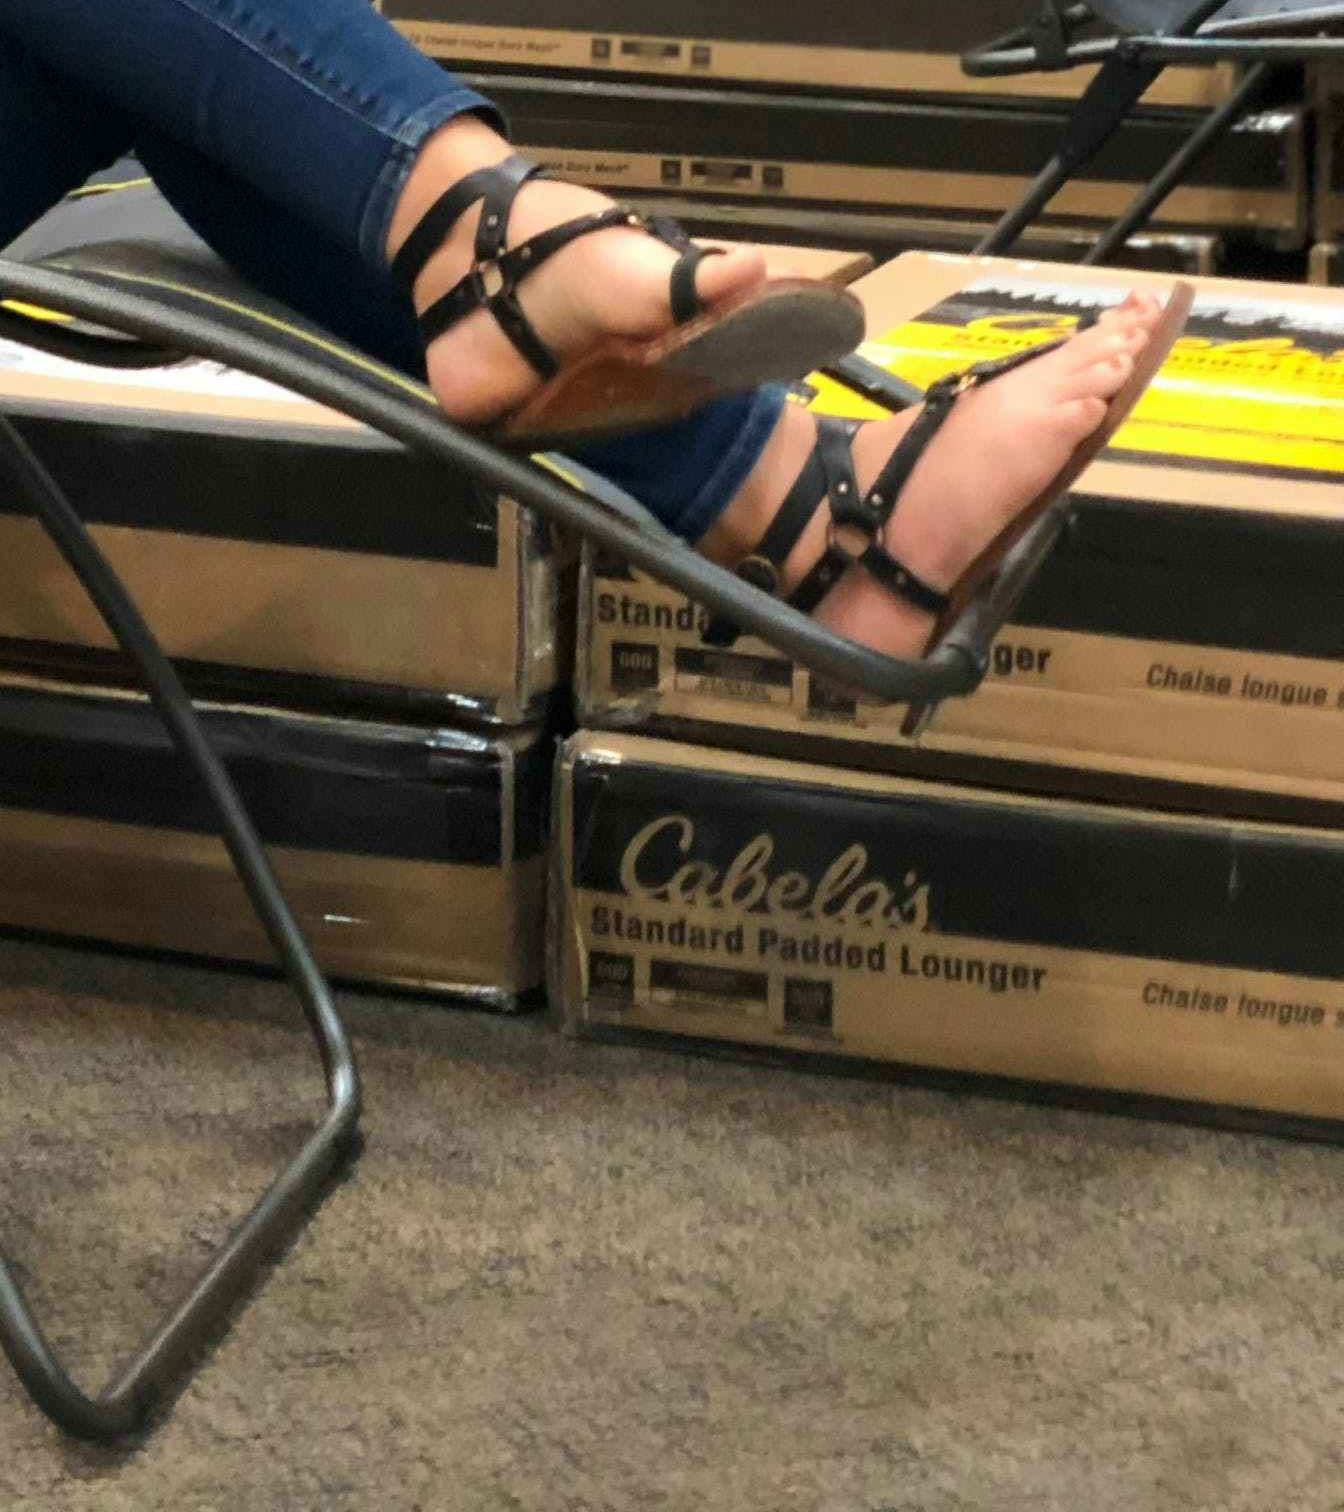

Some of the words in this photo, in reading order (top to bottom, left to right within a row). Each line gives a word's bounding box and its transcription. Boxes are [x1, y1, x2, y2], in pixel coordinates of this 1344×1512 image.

[1146, 663, 1232, 696] Chaise
[1241, 674, 1329, 706] longue
[619, 815, 931, 933] Cabela's
[590, 905, 744, 955] Standard
[757, 928, 886, 974] Padded
[899, 944, 1048, 994] Lounger
[1142, 981, 1230, 1015] Chaise
[1237, 992, 1325, 1029] longue
